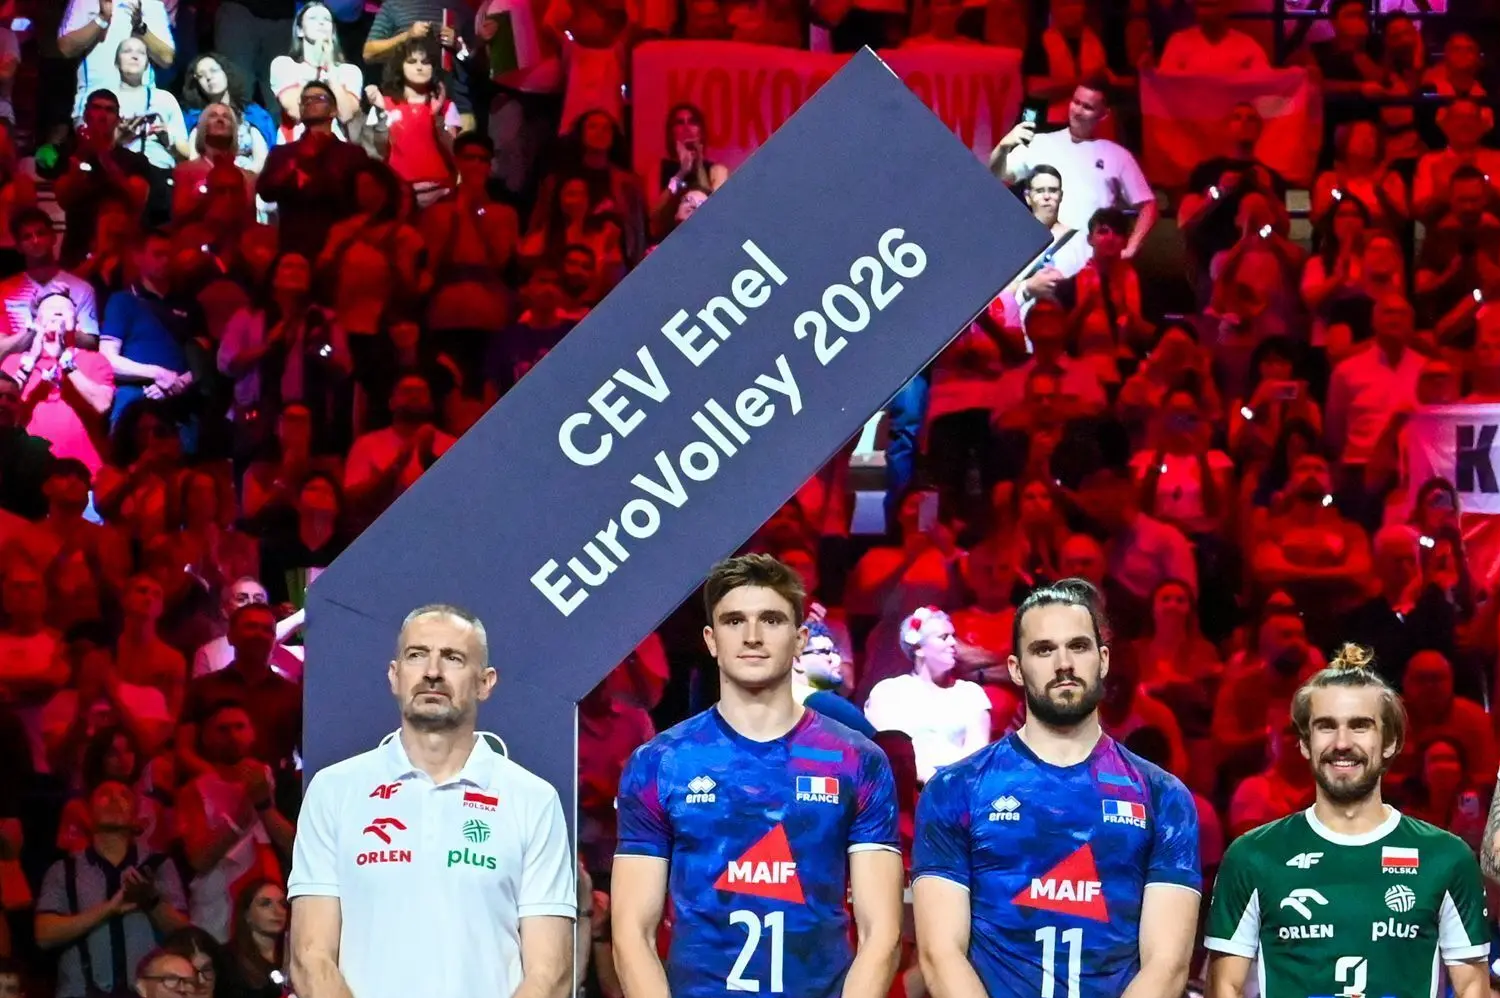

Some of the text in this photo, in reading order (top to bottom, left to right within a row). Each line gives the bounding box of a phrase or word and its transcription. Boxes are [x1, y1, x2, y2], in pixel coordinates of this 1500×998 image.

[558, 239, 789, 466] CEV Enel
[529, 227, 927, 617] EuroVolley 2026
[369, 782, 402, 799] 4F
[796, 793, 839, 804] FRANCE
[463, 802, 496, 812] POLSKA
[1103, 815, 1146, 829] FRANCE
[356, 850, 412, 866] ORLEN
[447, 848, 497, 870] plus
[1285, 852, 1325, 869] 4F
[727, 861, 797, 884] MAIF
[1382, 867, 1418, 875] POLSKA
[1030, 878, 1102, 902] MAIF
[1278, 924, 1334, 940] ORLEN
[1371, 917, 1420, 941] plus
[726, 909, 784, 993] 21
